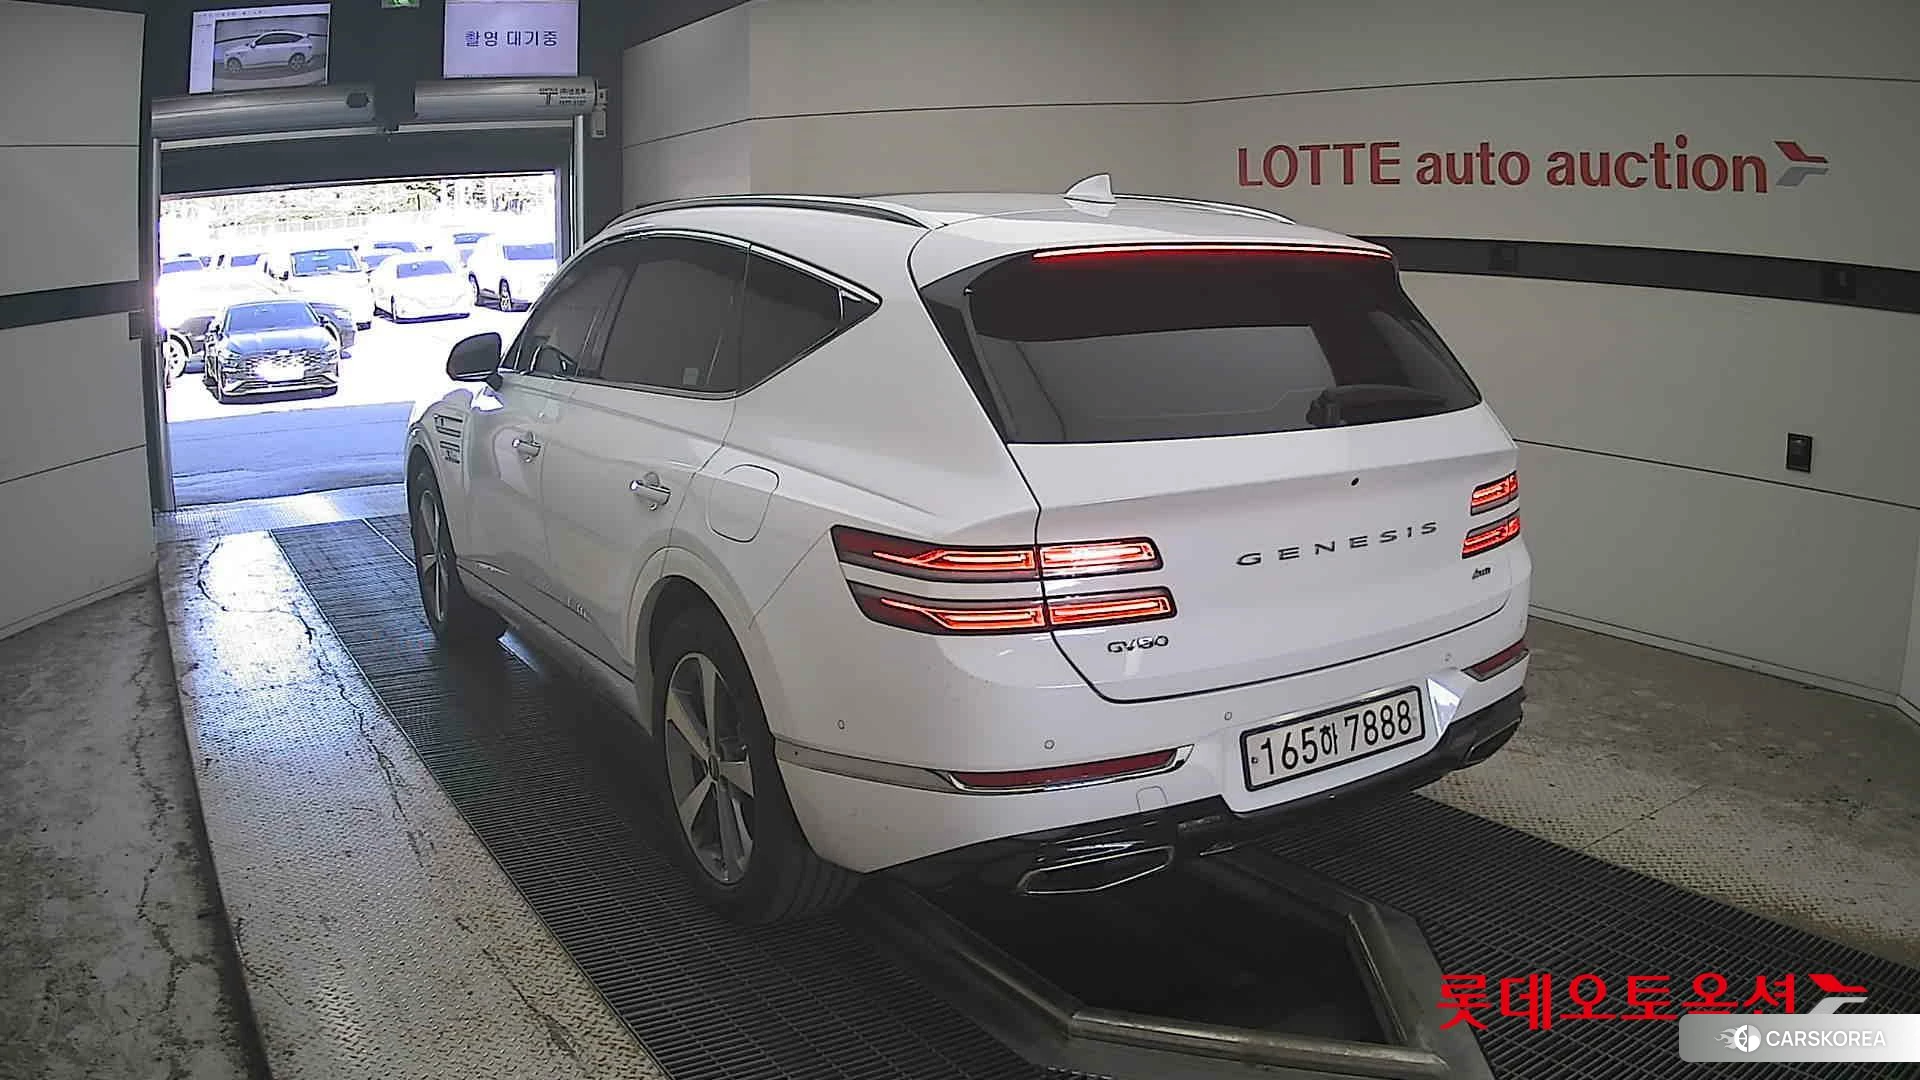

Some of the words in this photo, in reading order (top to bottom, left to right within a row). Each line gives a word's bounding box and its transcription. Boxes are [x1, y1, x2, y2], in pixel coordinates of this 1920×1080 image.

[506, 30, 558, 47] 대기중
[1238, 141, 1401, 188] LOTTE
[1415, 142, 1531, 186] auto
[1547, 134, 1768, 193] auction
[1236, 521, 1438, 567] GENESIS
[1107, 634, 1169, 653] GV80
[1260, 722, 1339, 776] 165하
[1343, 700, 1412, 752] 7888
